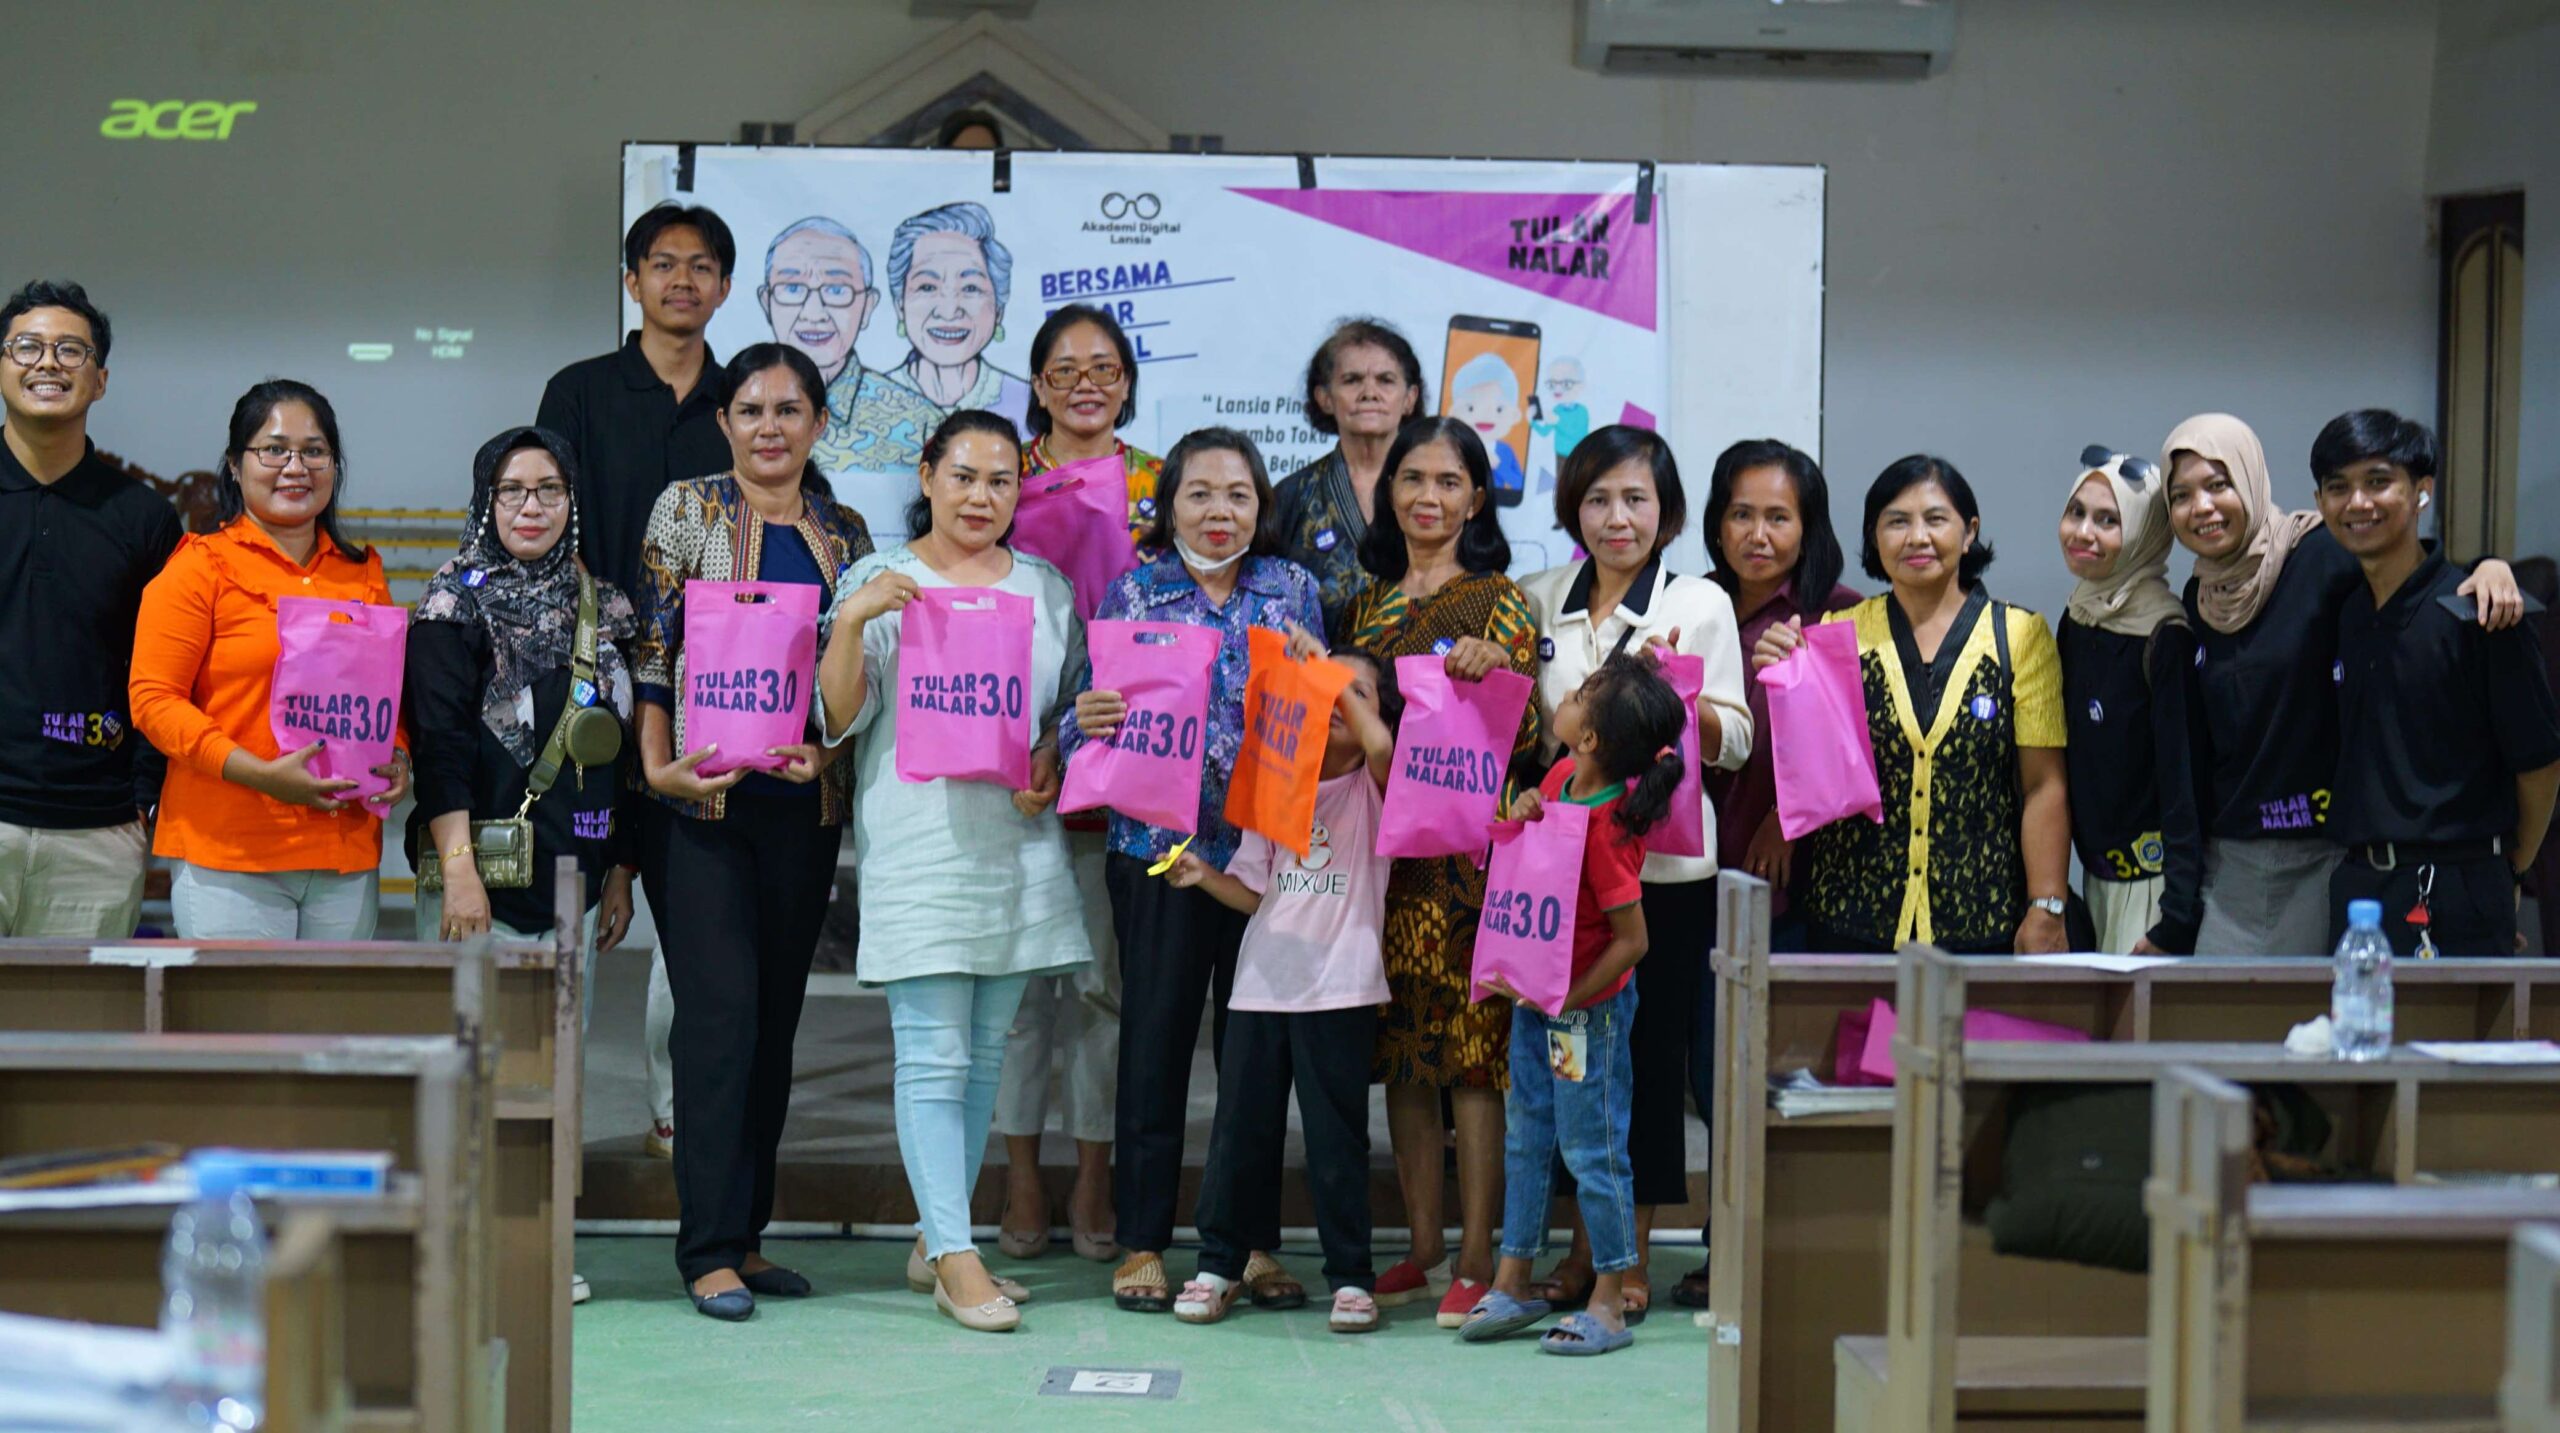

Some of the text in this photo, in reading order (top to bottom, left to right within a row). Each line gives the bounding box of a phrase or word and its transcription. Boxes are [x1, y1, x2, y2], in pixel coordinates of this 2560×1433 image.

[100, 99, 257, 140] acer
[1081, 222, 1181, 235] Akademi Digital
[1110, 235, 1152, 245] Lansia
[1509, 213, 1610, 244] TULAR
[1508, 246, 1610, 279] NALAR
[1041, 260, 1172, 298] BERSAMA
[1216, 395, 1270, 414] Lansia
[695, 668, 758, 690] TULAR
[911, 673, 977, 693] TULAR
[694, 691, 758, 713] NALAR
[759, 668, 797, 714] 3.0
[979, 673, 1022, 719] 3.0
[285, 694, 352, 715] TULAR
[911, 693, 977, 716] NALAR
[43, 712, 85, 728] TULAR
[284, 711, 352, 740] NALAR
[353, 695, 392, 743] 3.0
[42, 726, 84, 744] NALAR
[1151, 713, 1197, 760] 3.0
[1410, 747, 1464, 768] TULAR
[1405, 763, 1465, 792] NALAR
[1466, 749, 1498, 795] 3.0
[2260, 793, 2309, 817] TULAR
[2262, 811, 2313, 829] NALAR
[1277, 872, 1347, 895] MIXUE
[1512, 891, 1560, 942] 3.0
